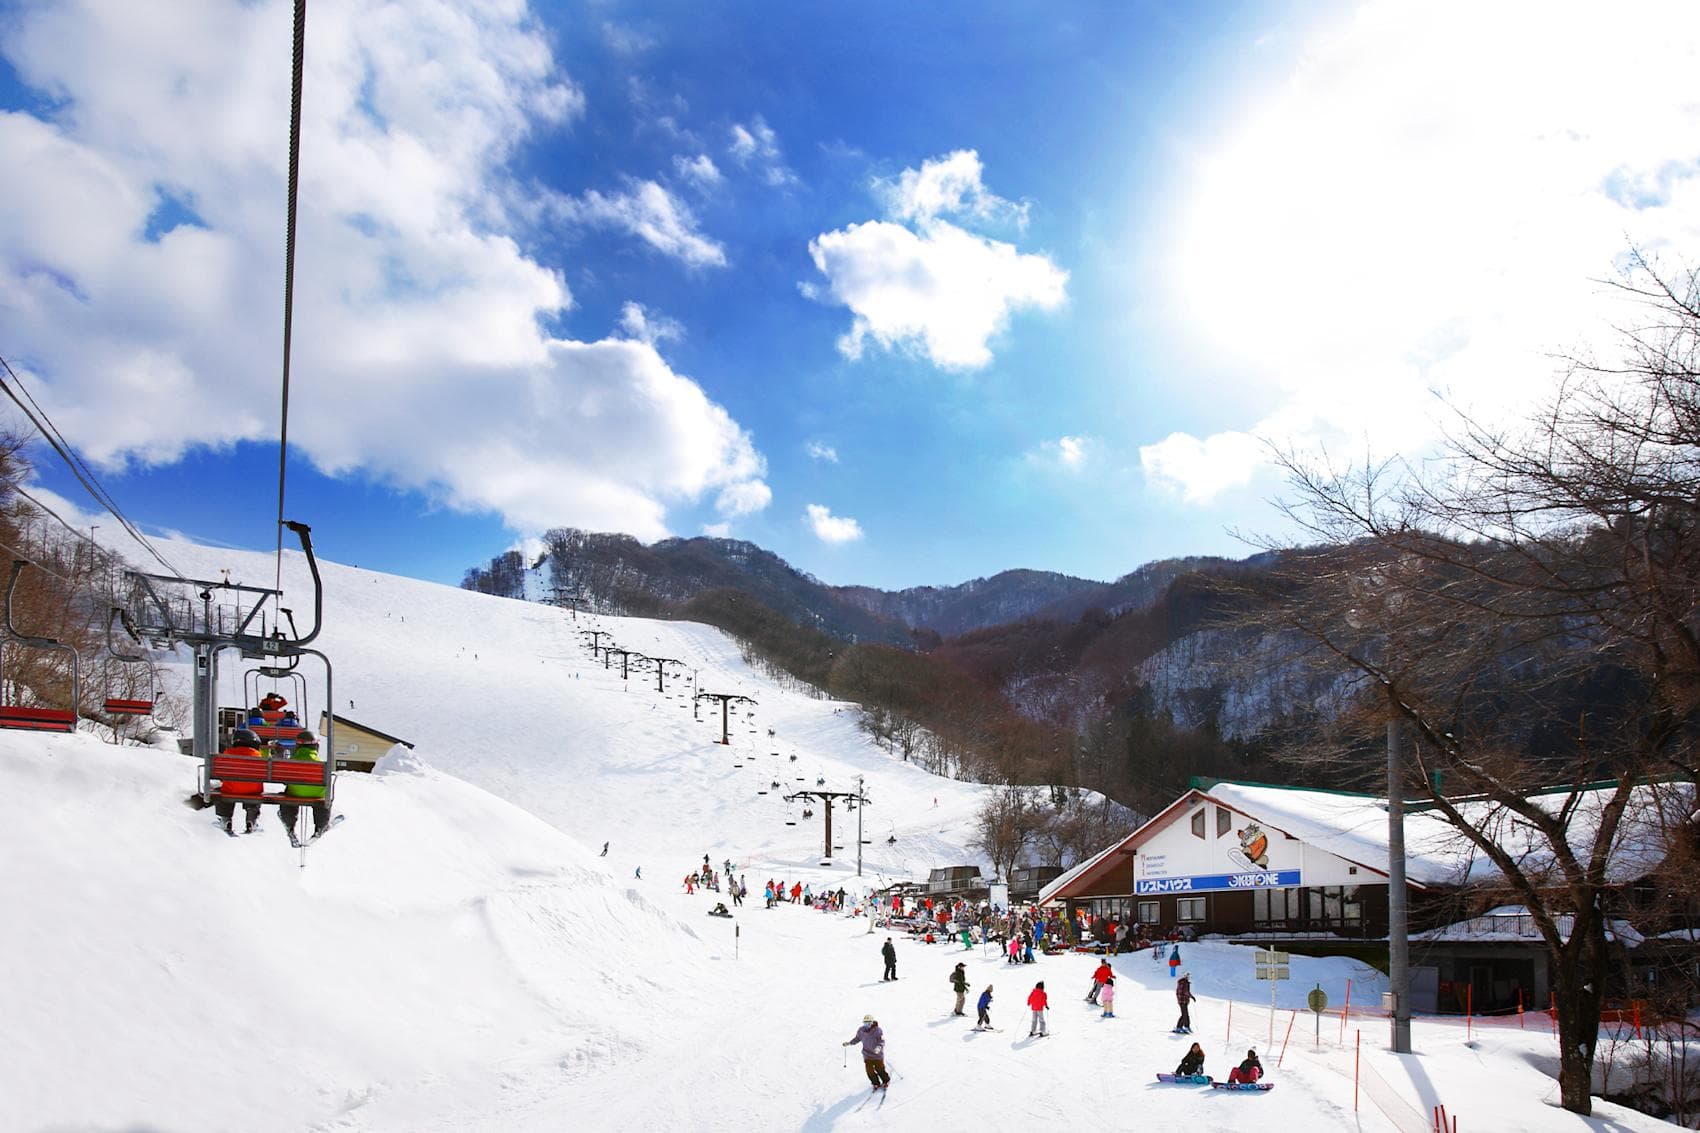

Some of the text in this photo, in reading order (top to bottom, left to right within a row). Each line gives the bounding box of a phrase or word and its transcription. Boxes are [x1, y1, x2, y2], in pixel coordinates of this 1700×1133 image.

[265, 641, 276, 650] 42
[1140, 879, 1192, 892] レストハウス
